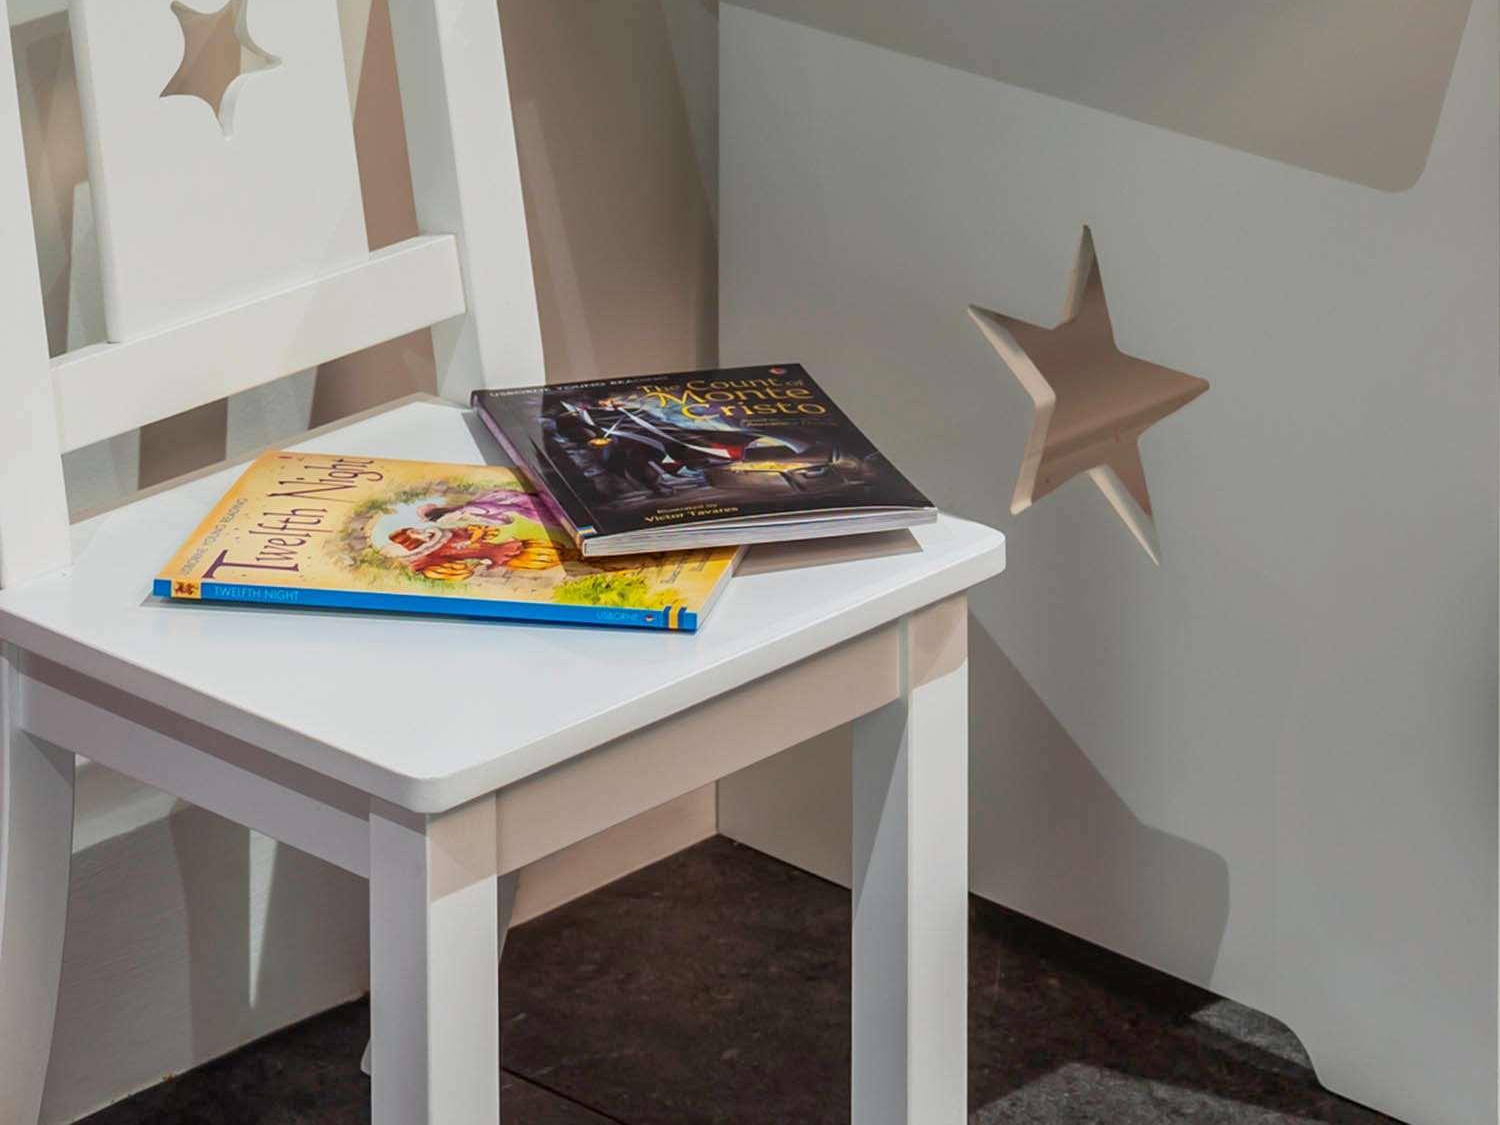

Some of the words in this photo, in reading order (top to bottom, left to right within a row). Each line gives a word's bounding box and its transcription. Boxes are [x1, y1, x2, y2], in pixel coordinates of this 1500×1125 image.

[685, 376, 783, 393] Count
[638, 384, 815, 409] Monte
[680, 400, 828, 421] Cristo
[266, 457, 385, 504] Night
[201, 507, 335, 580] Twelfth
[213, 585, 262, 599] TWELFTH
[263, 589, 300, 602] NIGHT
